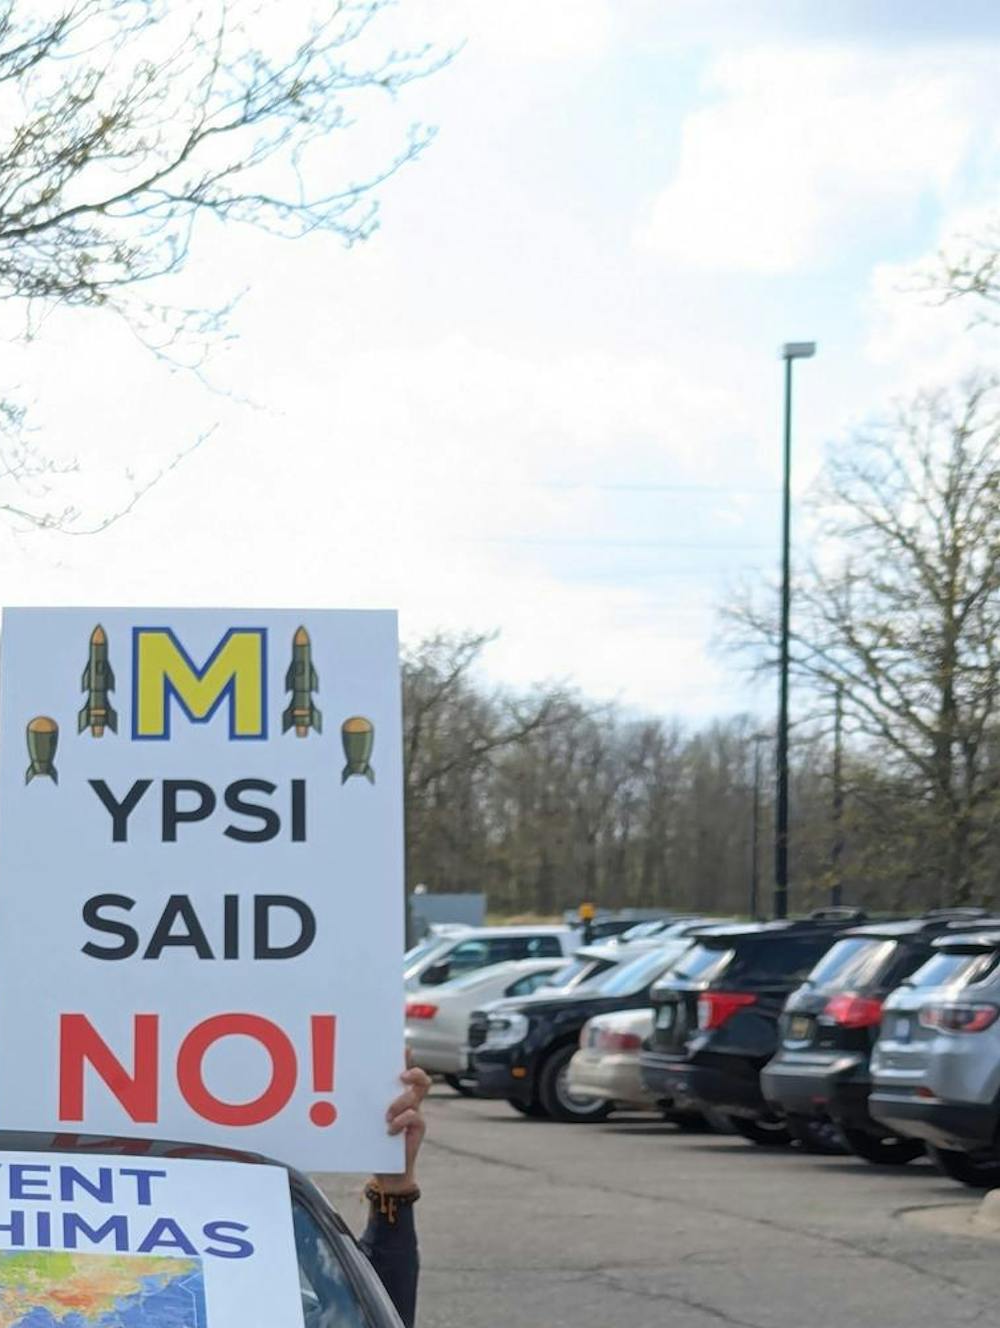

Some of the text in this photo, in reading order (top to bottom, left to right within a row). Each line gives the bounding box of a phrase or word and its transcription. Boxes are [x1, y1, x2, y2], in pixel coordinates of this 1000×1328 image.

[131, 627, 268, 741] M
[88, 778, 307, 843] YPSI
[81, 893, 318, 961] SAID
[58, 1013, 338, 1128] NO!
